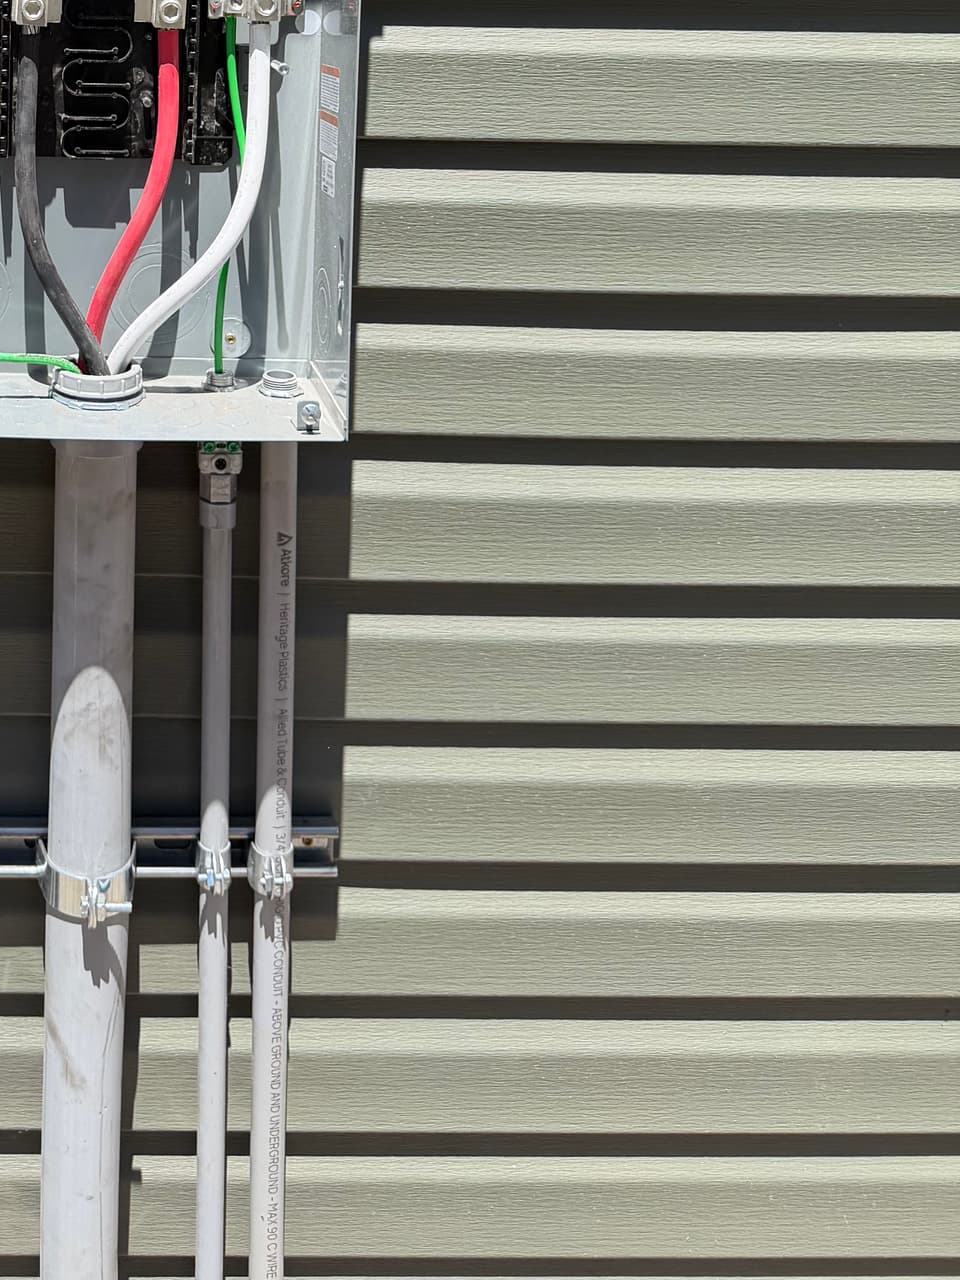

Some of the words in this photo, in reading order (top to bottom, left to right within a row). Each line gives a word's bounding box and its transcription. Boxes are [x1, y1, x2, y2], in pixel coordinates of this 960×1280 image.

[280, 548, 292, 587] Atkore
[275, 603, 290, 649] Heritage
[278, 651, 289, 691] Plastics
[277, 709, 288, 736] Allied
[276, 740, 288, 766] Tube
[276, 768, 287, 776] &
[275, 777, 287, 819] Conduit
[273, 950, 284, 997] CONDUIT
[271, 1008, 282, 1042] ABOVE
[271, 1046, 282, 1089] GROUND
[270, 1093, 281, 1113] AND
[268, 1116, 280, 1194] UNDERGROUND
[267, 1225, 278, 1240] 90
[267, 1243, 277, 1251] C
[266, 1254, 277, 1279] WIRE
